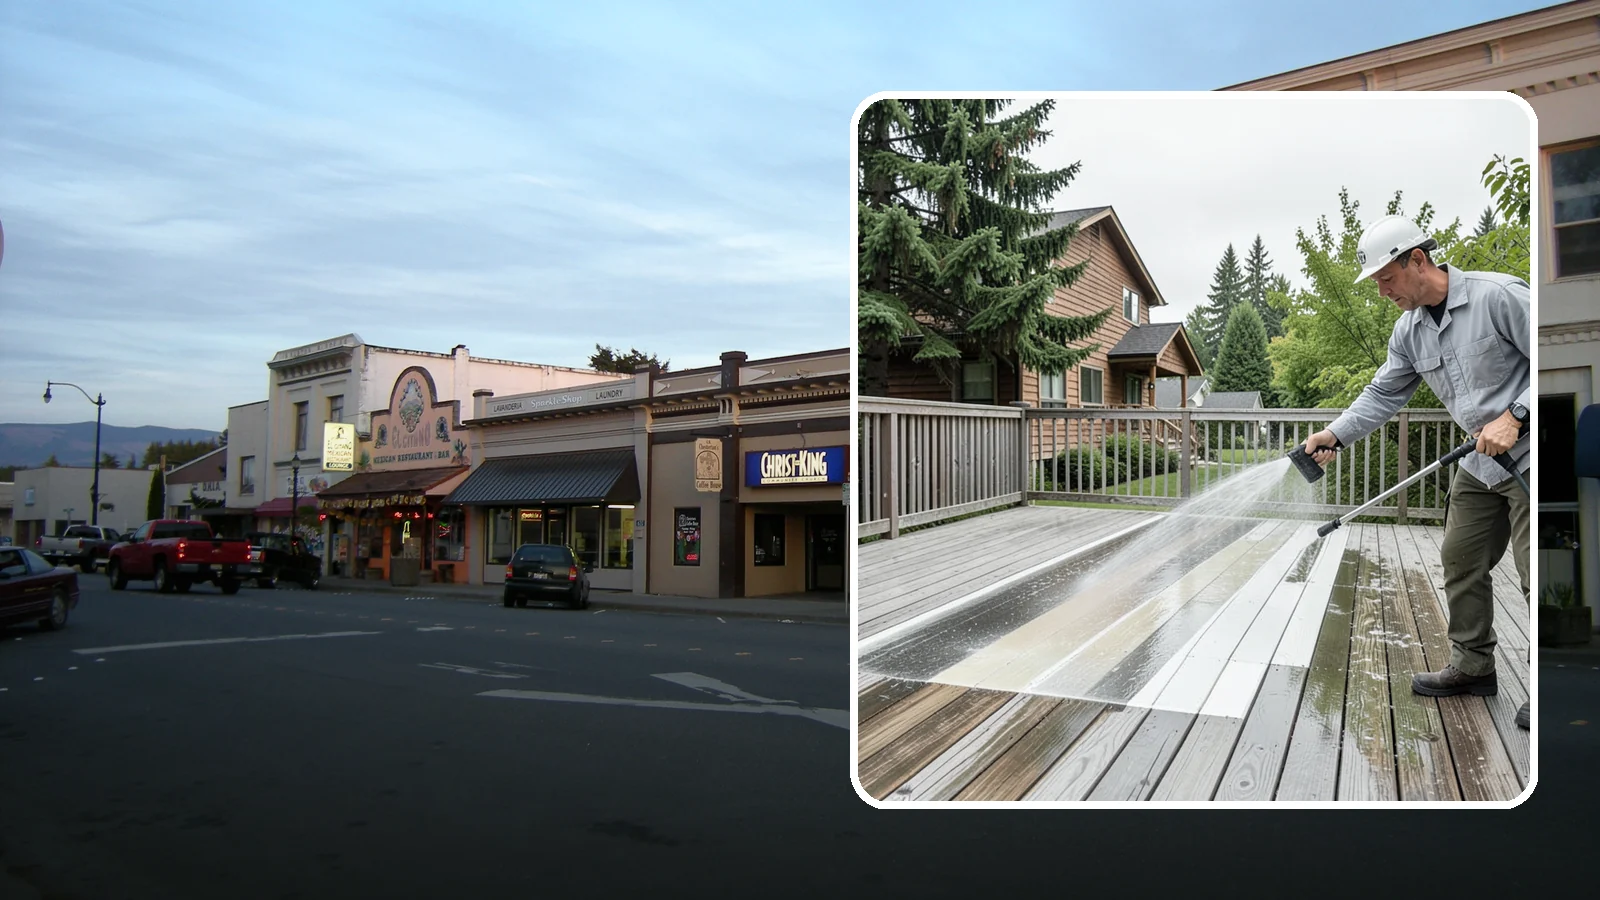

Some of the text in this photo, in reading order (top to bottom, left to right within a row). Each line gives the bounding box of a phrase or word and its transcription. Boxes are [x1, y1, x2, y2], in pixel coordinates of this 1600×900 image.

[494, 389, 623, 413] LAVANDERIA Sparkle Shop LAUNDRY
[397, 451, 433, 462] RESTAURANT
[438, 450, 450, 459] BAR
[760, 449, 828, 478] CHRIST KING
